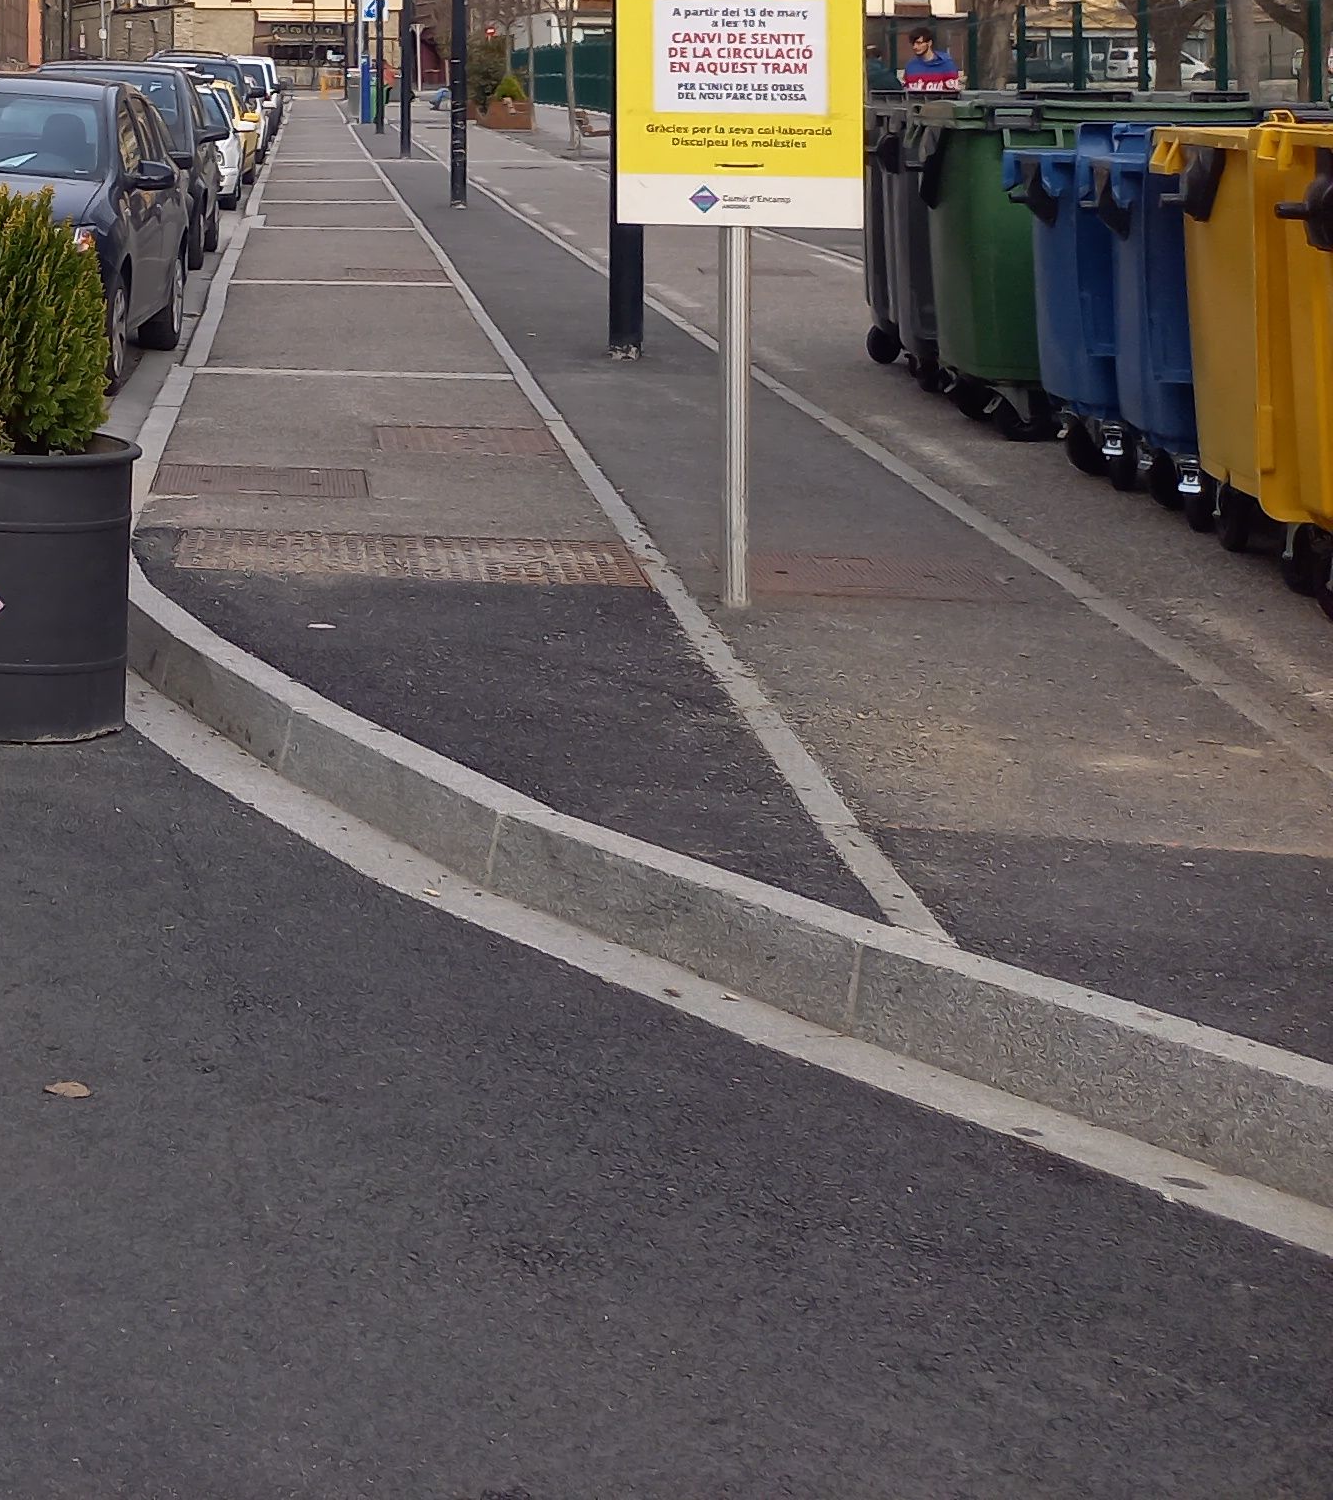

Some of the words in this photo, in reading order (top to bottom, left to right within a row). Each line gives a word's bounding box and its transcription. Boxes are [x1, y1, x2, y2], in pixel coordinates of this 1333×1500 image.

[672, 7, 682, 17] A
[684, 8, 720, 19] partir
[721, 7, 740, 17] del
[759, 7, 774, 18] de
[777, 9, 808, 20] març
[721, 18, 738, 28] les
[743, 18, 755, 28] 10
[671, 32, 722, 44] CANVI
[727, 33, 747, 45] DE
[750, 33, 805, 45] SENTIT
[668, 47, 688, 58] DE
[692, 47, 712, 59] LA
[717, 45, 813, 60] CIRCULACIÓ
[669, 62, 690, 73] EN
[695, 62, 757, 76] AQUEST
[762, 63, 808, 74] TRAM
[677, 83, 696, 91] PER
[735, 83, 748, 92] DE
[751, 84, 768, 92] LES
[677, 92, 696, 100] DEL
[699, 92, 723, 100] NOU
[726, 93, 752, 101] PARC
[755, 93, 768, 101] DE
[692, 126, 711, 136] per
[715, 124, 725, 134] la
[671, 137, 729, 148] Disculpeu
